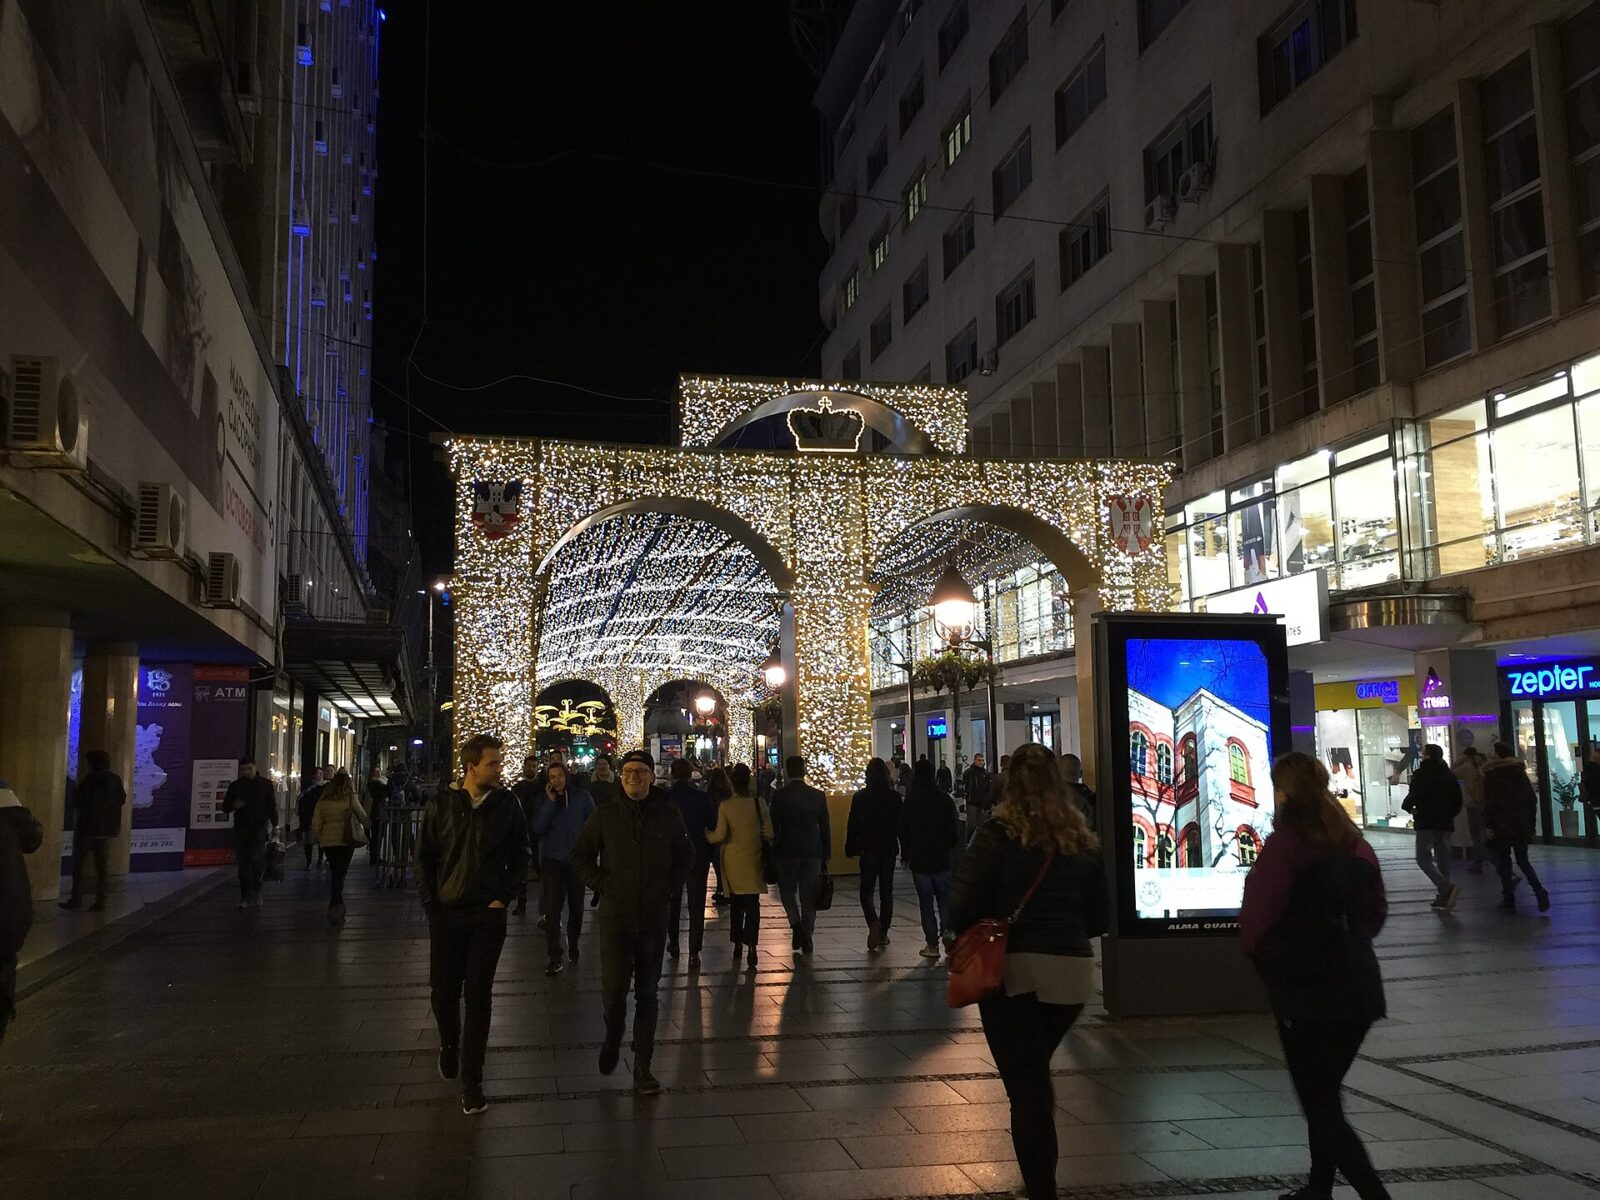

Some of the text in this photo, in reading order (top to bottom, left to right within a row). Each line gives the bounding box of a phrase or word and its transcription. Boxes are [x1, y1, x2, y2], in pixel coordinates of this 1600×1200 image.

[1507, 664, 1594, 696] zepter
[214, 687, 246, 698] ATM
[1356, 682, 1399, 699] OFFICE
[1167, 923, 1200, 931] ALMA
